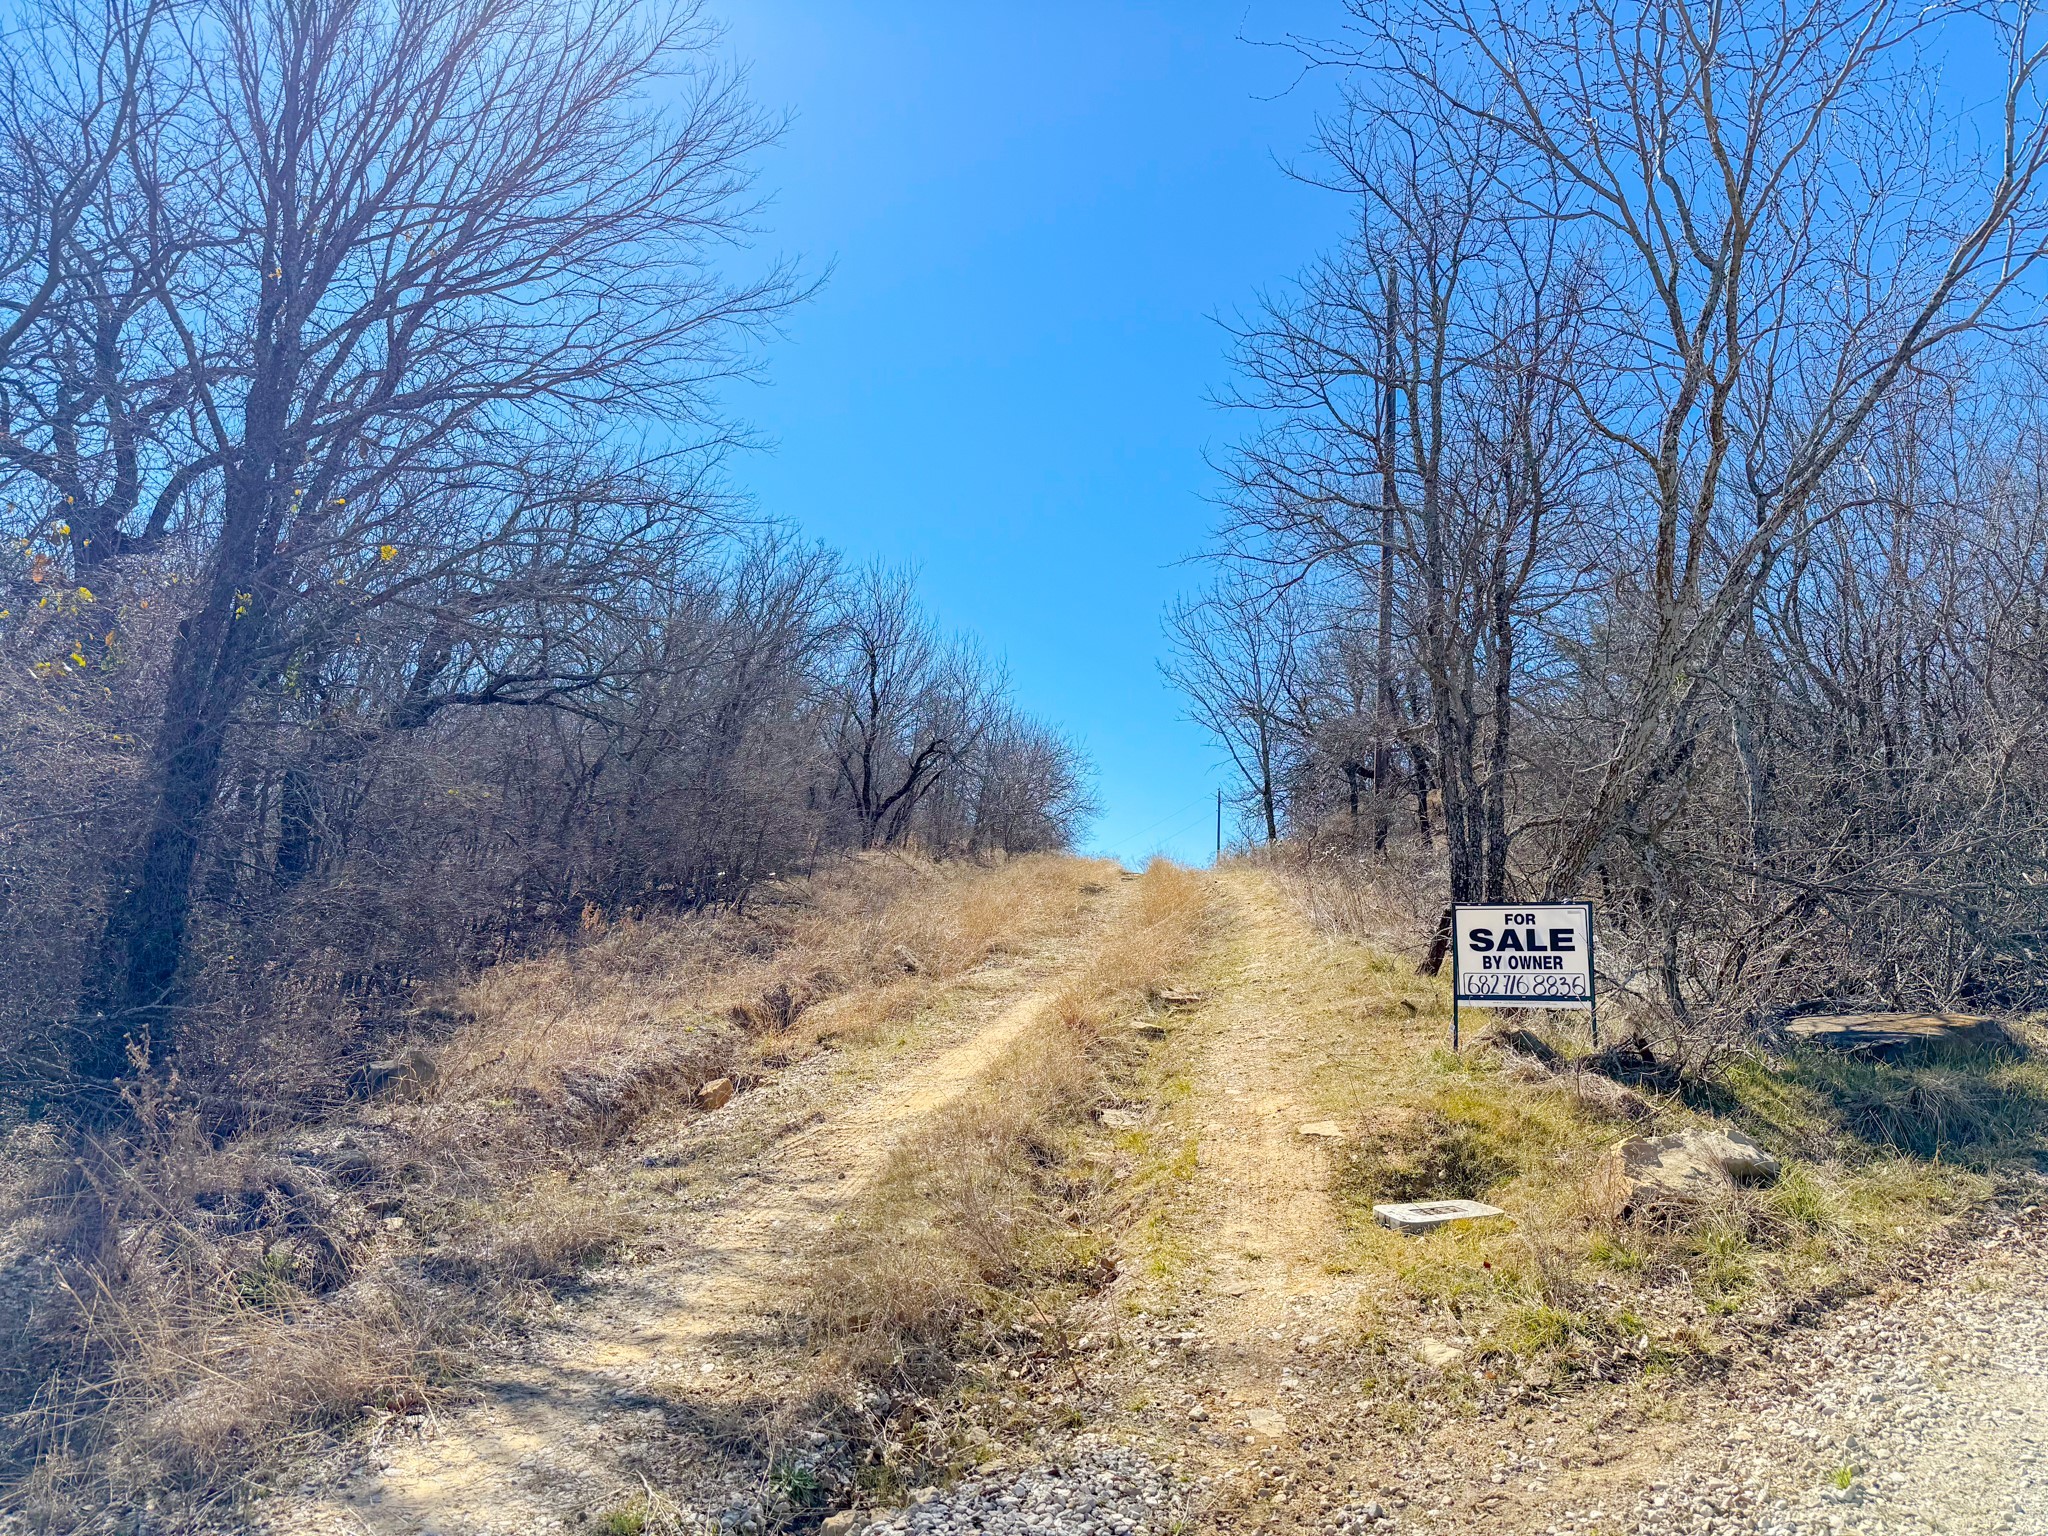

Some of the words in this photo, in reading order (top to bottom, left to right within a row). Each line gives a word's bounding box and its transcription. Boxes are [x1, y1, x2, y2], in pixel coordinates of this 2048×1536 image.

[1504, 913, 1536, 925] FOR
[1469, 928, 1576, 952] SALE
[1482, 955, 1502, 970] BY
[1508, 955, 1563, 970] OWNER
